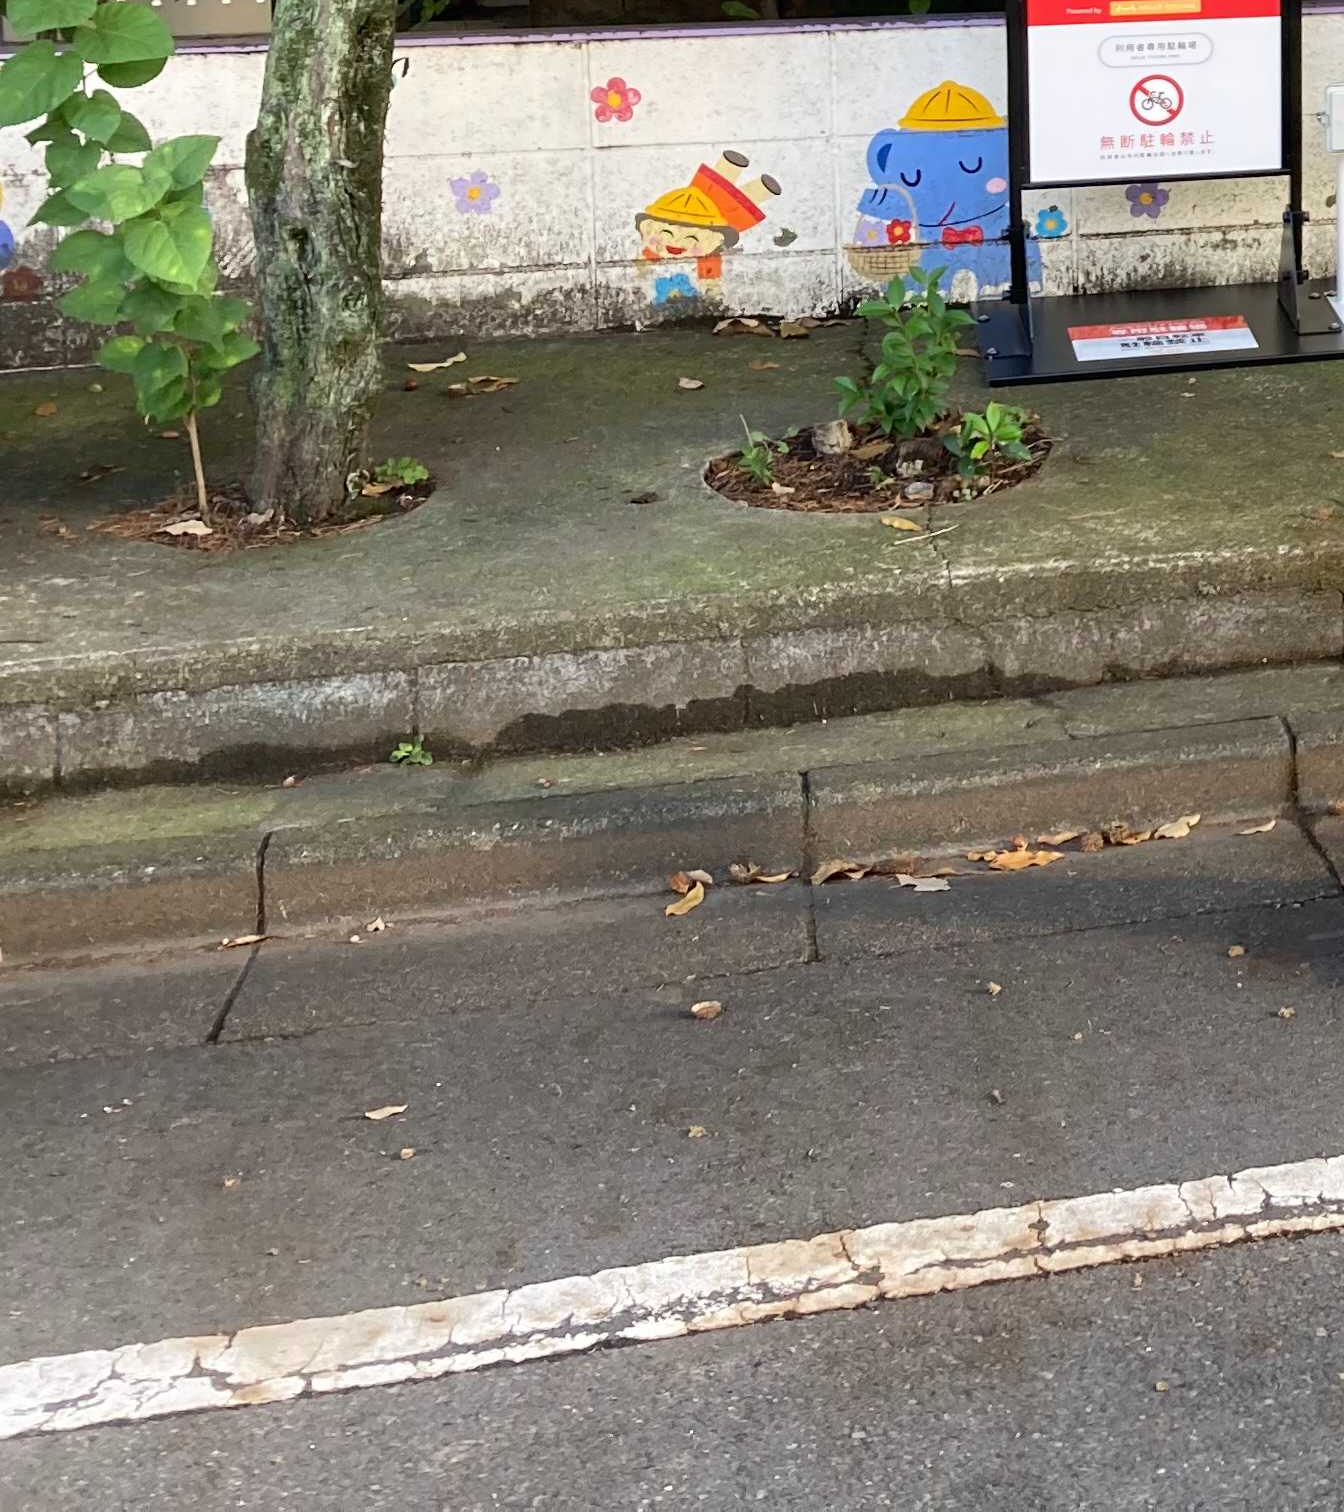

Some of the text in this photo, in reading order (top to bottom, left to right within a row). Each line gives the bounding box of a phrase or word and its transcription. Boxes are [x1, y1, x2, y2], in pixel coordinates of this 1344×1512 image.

[1099, 129, 1215, 150] 無断駐輪禁止
